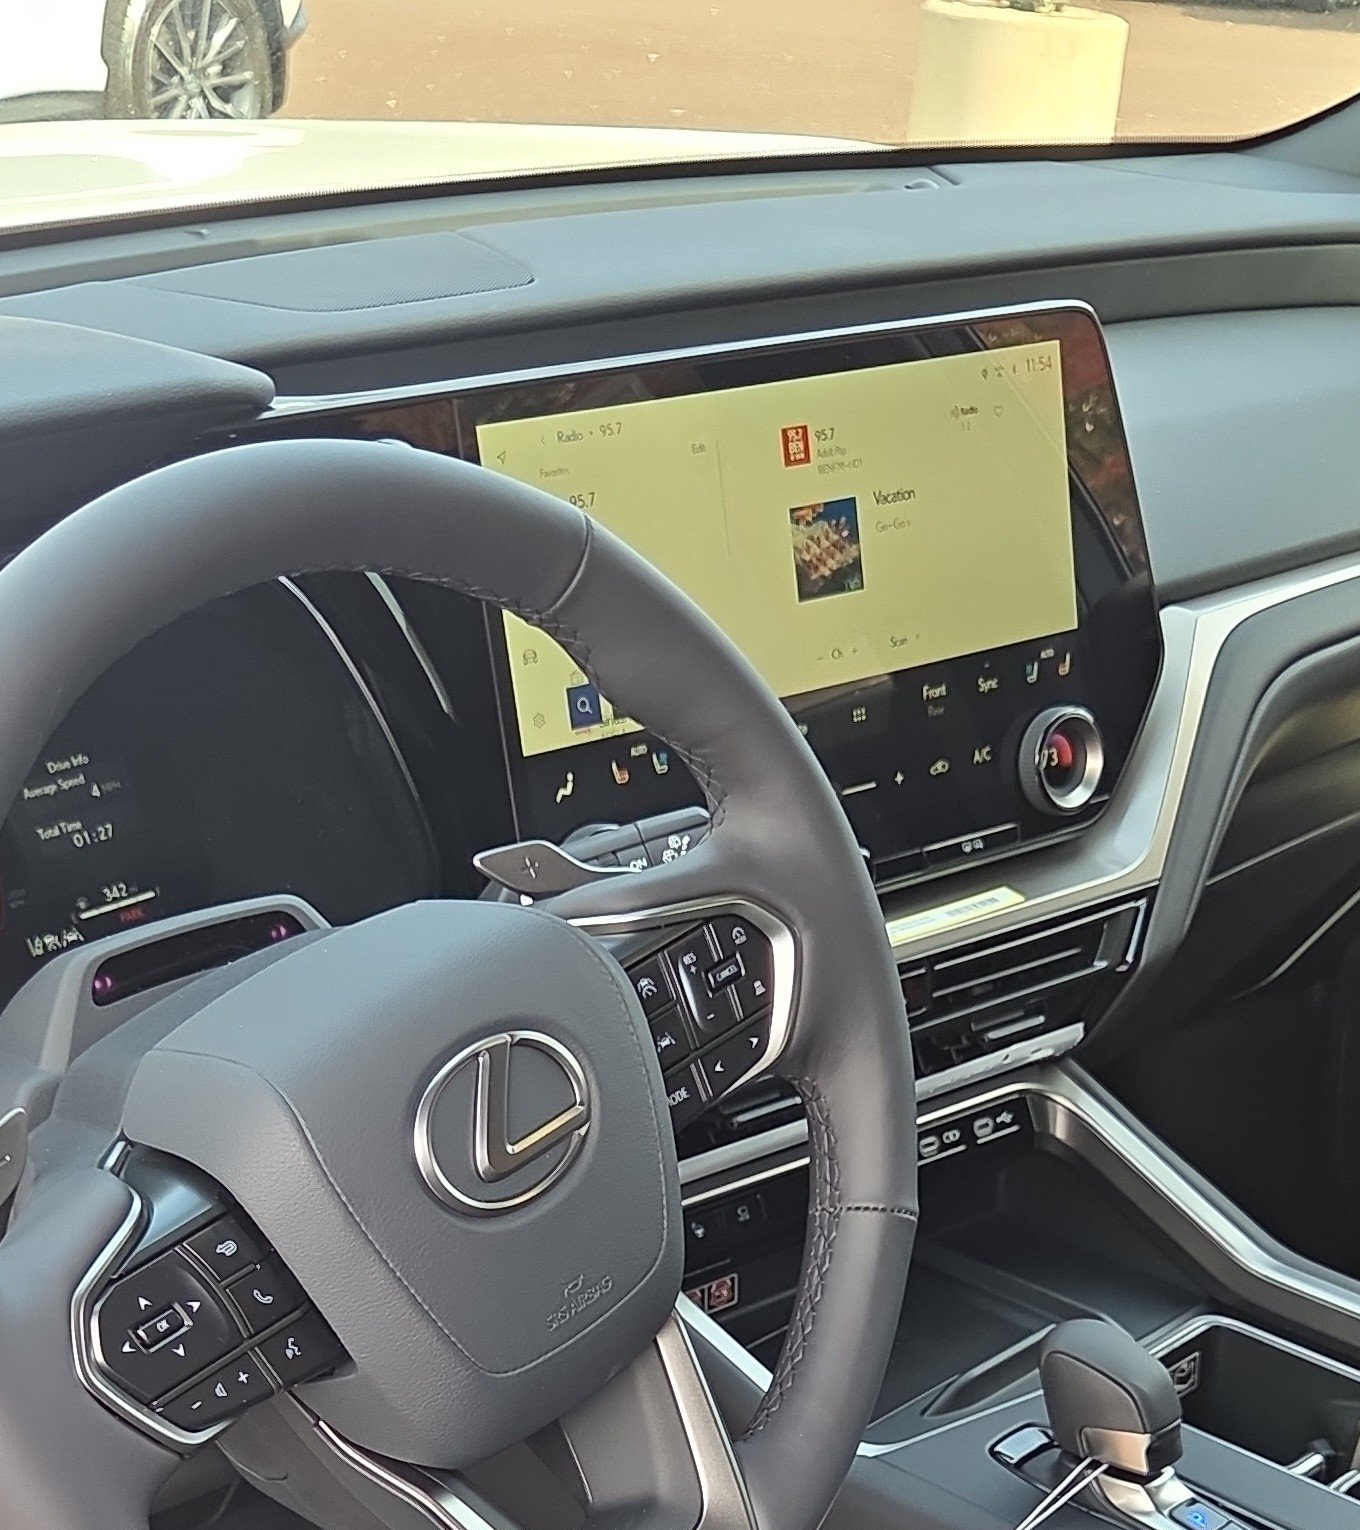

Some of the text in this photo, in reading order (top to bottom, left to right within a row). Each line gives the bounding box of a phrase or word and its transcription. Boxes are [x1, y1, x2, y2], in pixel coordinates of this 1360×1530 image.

[556, 422, 622, 443] Radio 95.7
[872, 488, 917, 506] Vacation
[922, 684, 947, 700] Front
[977, 676, 999, 694] Sync
[973, 745, 992, 764] A/C
[72, 823, 113, 848] 01:27
[102, 882, 128, 902] 342
[668, 1086, 691, 1107] ODE
